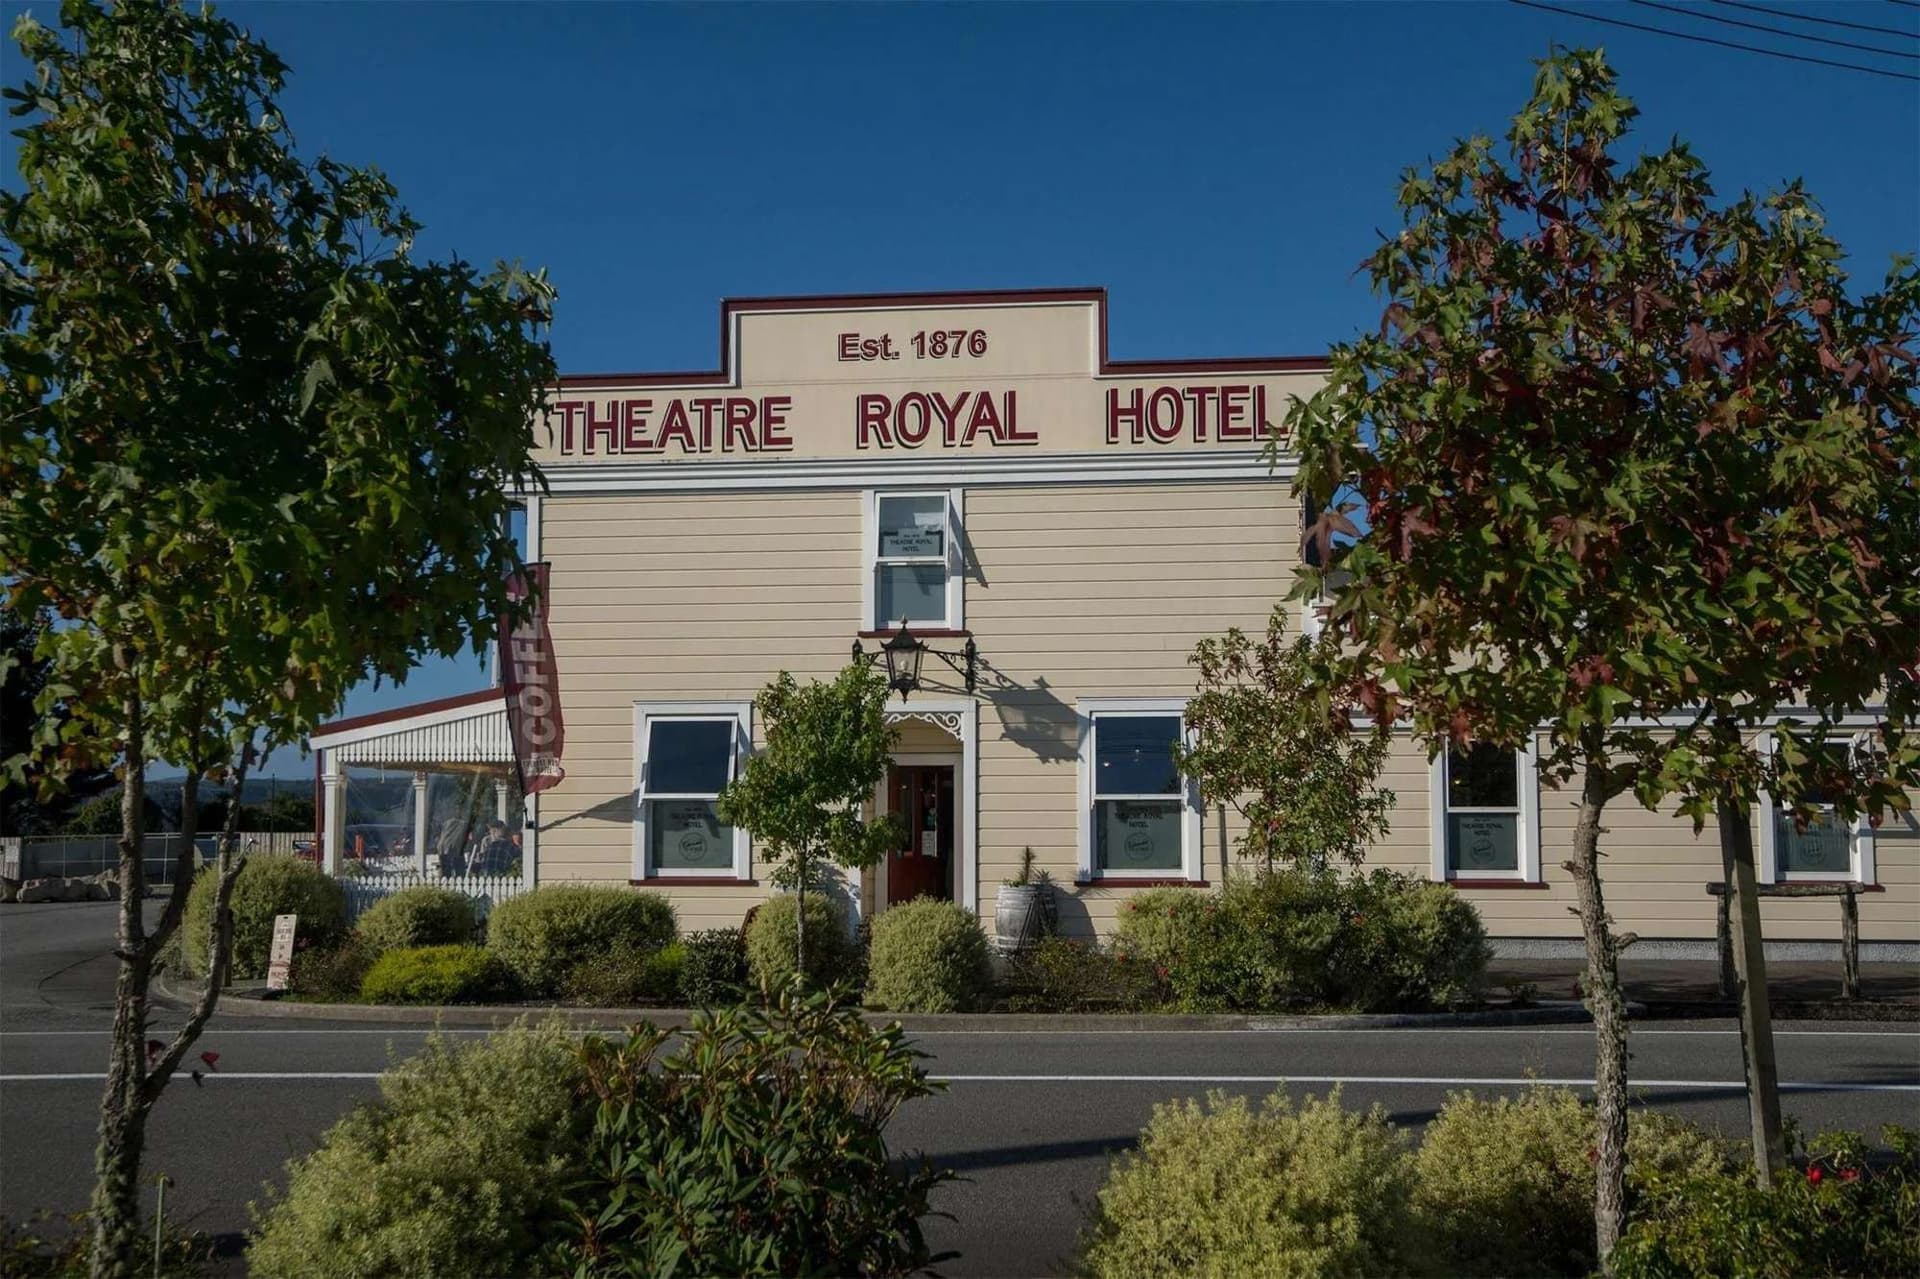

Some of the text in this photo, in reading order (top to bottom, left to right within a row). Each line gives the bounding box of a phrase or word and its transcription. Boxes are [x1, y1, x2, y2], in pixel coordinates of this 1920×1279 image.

[838, 329, 988, 361] Est. 1876
[552, 384, 1288, 454] THEATRE ROYAL HOTEL
[511, 593, 557, 745] COFFE
